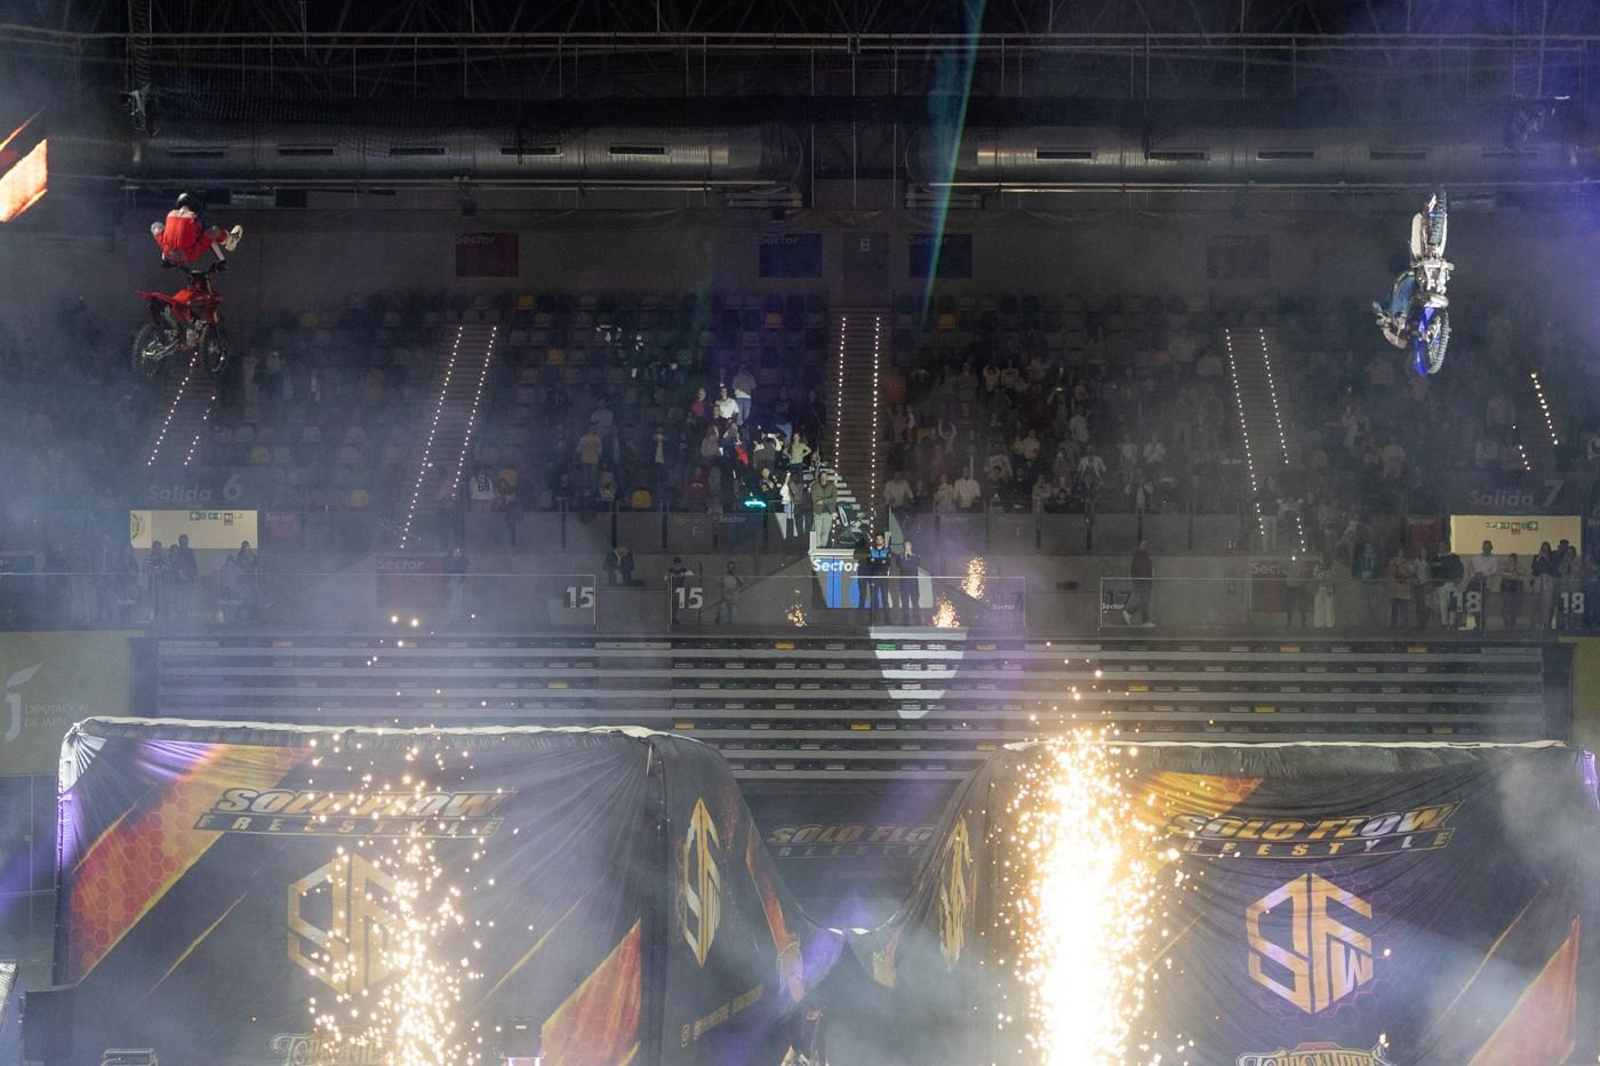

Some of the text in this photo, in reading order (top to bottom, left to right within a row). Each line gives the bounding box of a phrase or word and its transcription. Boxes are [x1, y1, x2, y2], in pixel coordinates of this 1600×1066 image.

[150, 473, 242, 501] Salida 6
[1468, 479, 1564, 508] Salida 7
[376, 557, 424, 570] Sector
[813, 559, 859, 572] Sector
[566, 586, 594, 609] 15
[675, 587, 704, 610] 15
[1454, 590, 1481, 613] 18
[1561, 592, 1585, 613] 18
[767, 825, 936, 843] SOLO FLO
[1165, 804, 1452, 841] SOLO FLOW
